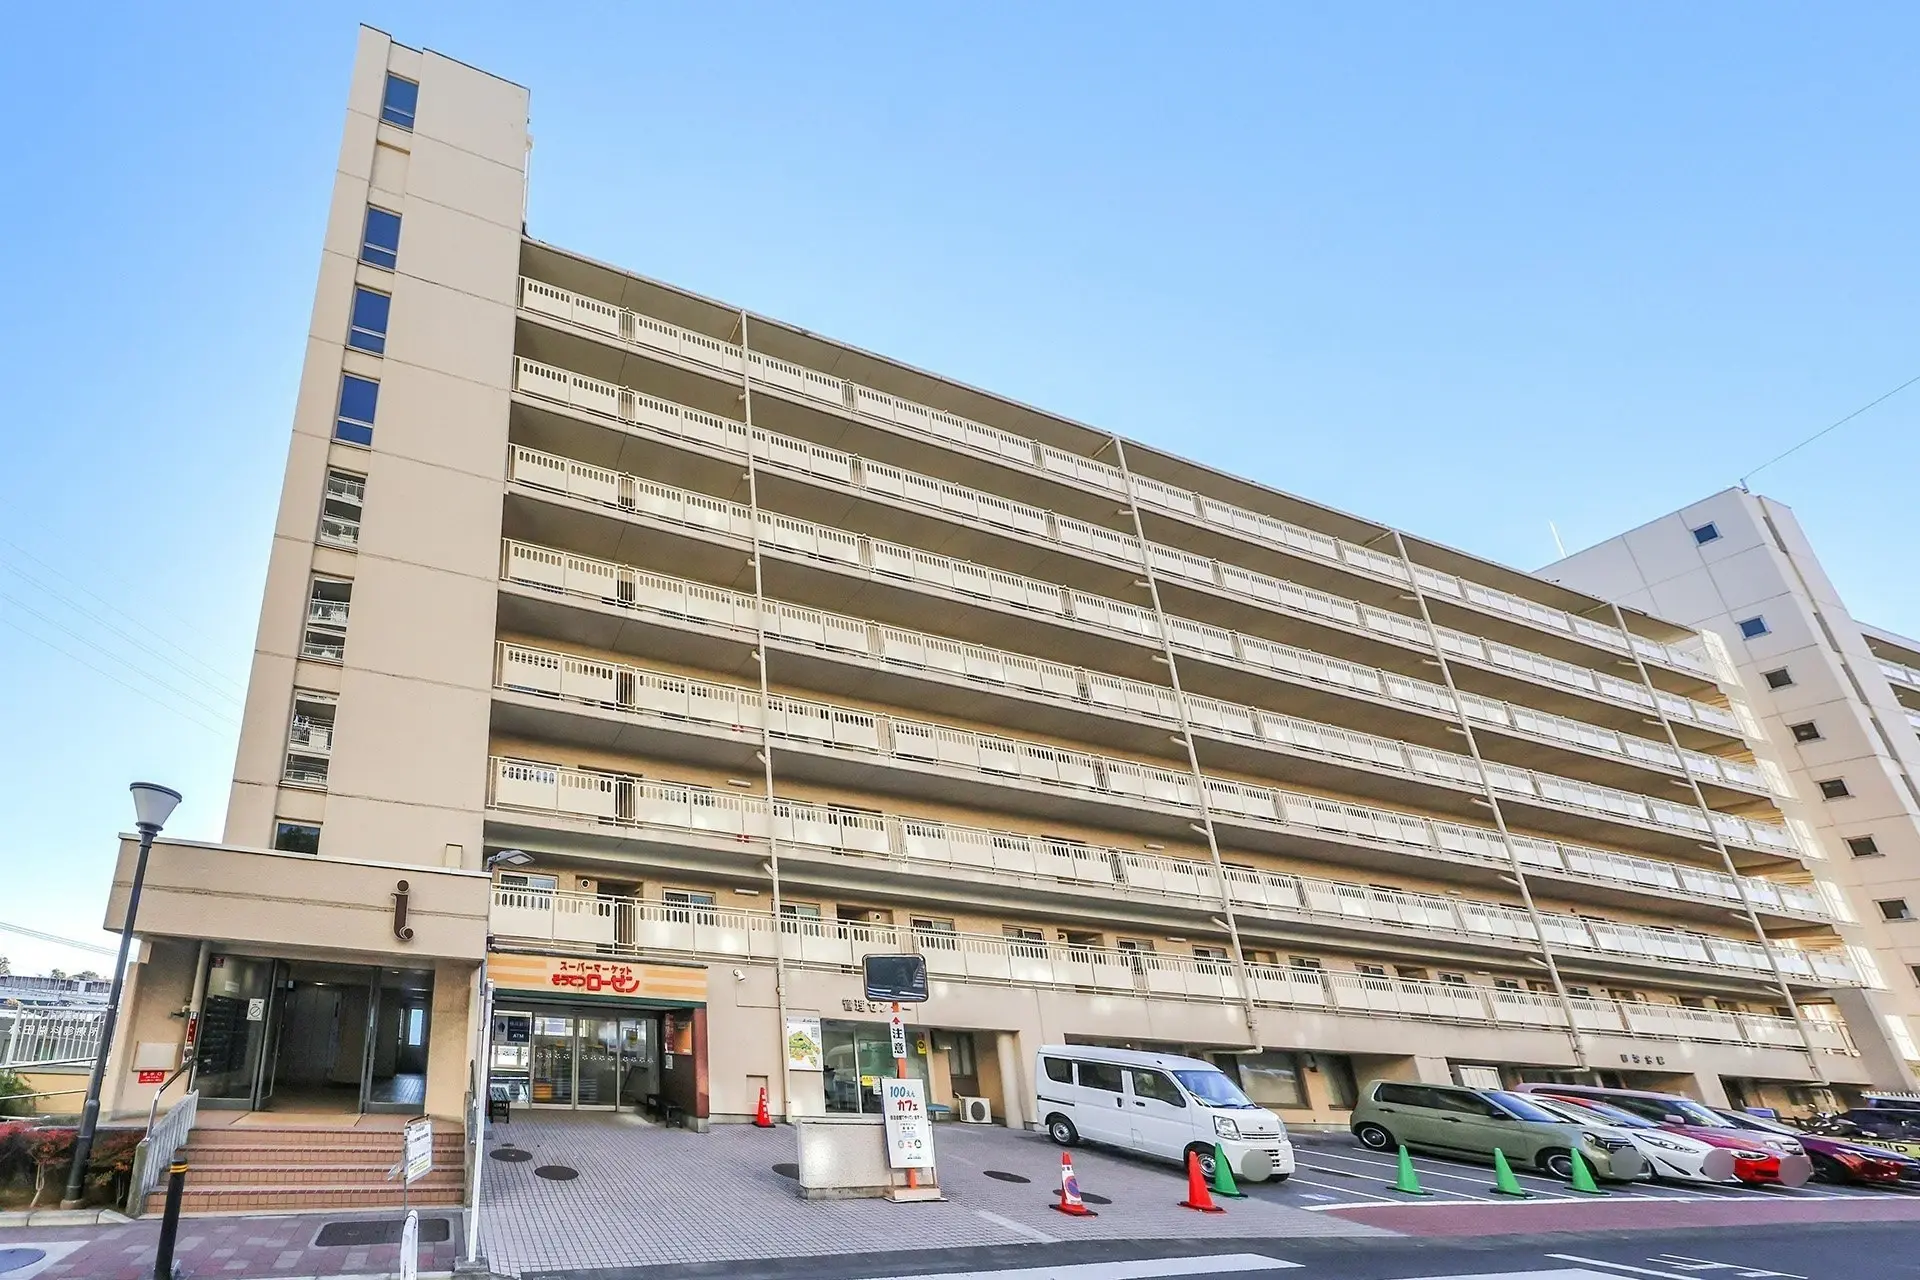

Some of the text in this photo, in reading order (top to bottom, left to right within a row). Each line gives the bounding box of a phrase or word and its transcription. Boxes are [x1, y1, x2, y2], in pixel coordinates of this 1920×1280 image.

[560, 961, 632, 975] スーパーマーケット
[552, 974, 640, 993] そうてつローゼン
[842, 999, 911, 1013] 管理センー
[892, 1028, 905, 1054] 注意
[890, 1086, 916, 1098] 100えん
[897, 1100, 918, 1111] カフェ
